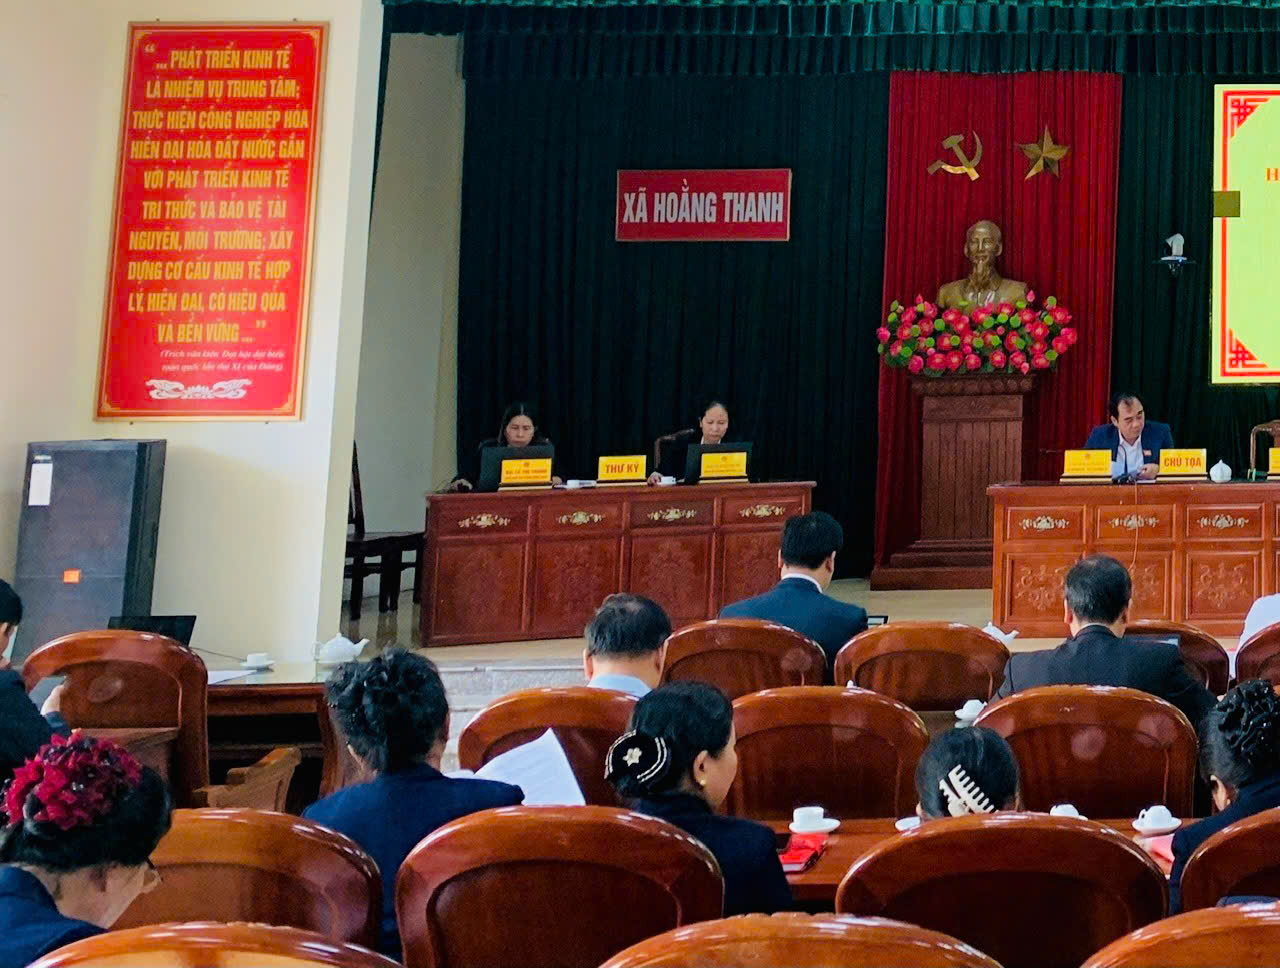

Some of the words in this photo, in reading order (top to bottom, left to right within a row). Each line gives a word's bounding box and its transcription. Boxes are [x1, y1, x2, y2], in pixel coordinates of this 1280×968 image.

[243, 50, 272, 69] KINH
[276, 43, 292, 69] TẾ
[164, 76, 204, 102] NHIỆM
[208, 80, 224, 102] VỤ
[227, 80, 267, 98] TRUNG
[167, 105, 196, 132] HIỆN
[199, 105, 232, 129] CÔNG
[242, 170, 272, 188] KINH
[623, 187, 648, 223] XÃ
[653, 178, 717, 223] HOẰNG
[722, 192, 784, 223] THANH
[213, 261, 244, 280] KINH
